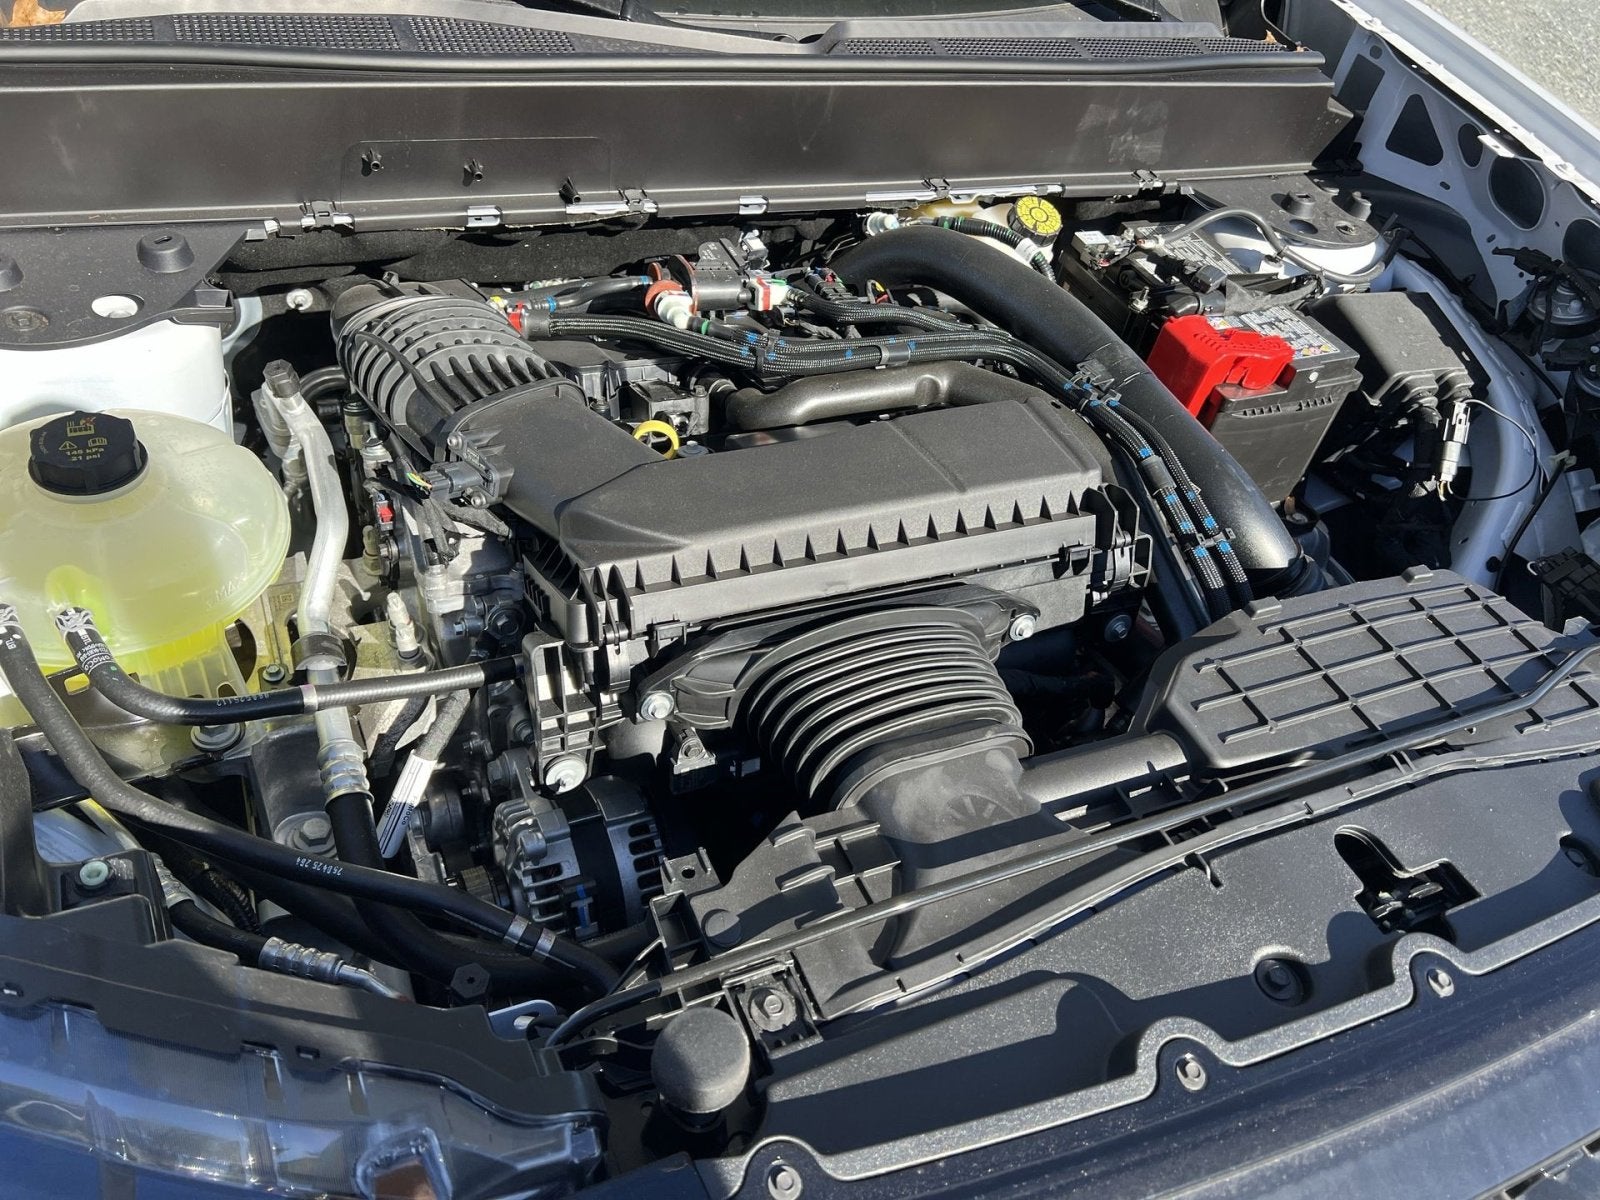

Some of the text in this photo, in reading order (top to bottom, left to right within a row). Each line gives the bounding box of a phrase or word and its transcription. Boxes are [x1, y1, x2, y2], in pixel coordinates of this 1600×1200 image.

[86, 447, 105, 455] kPa
[86, 453, 100, 461] psi
[85, 654, 112, 671] oMoCo
